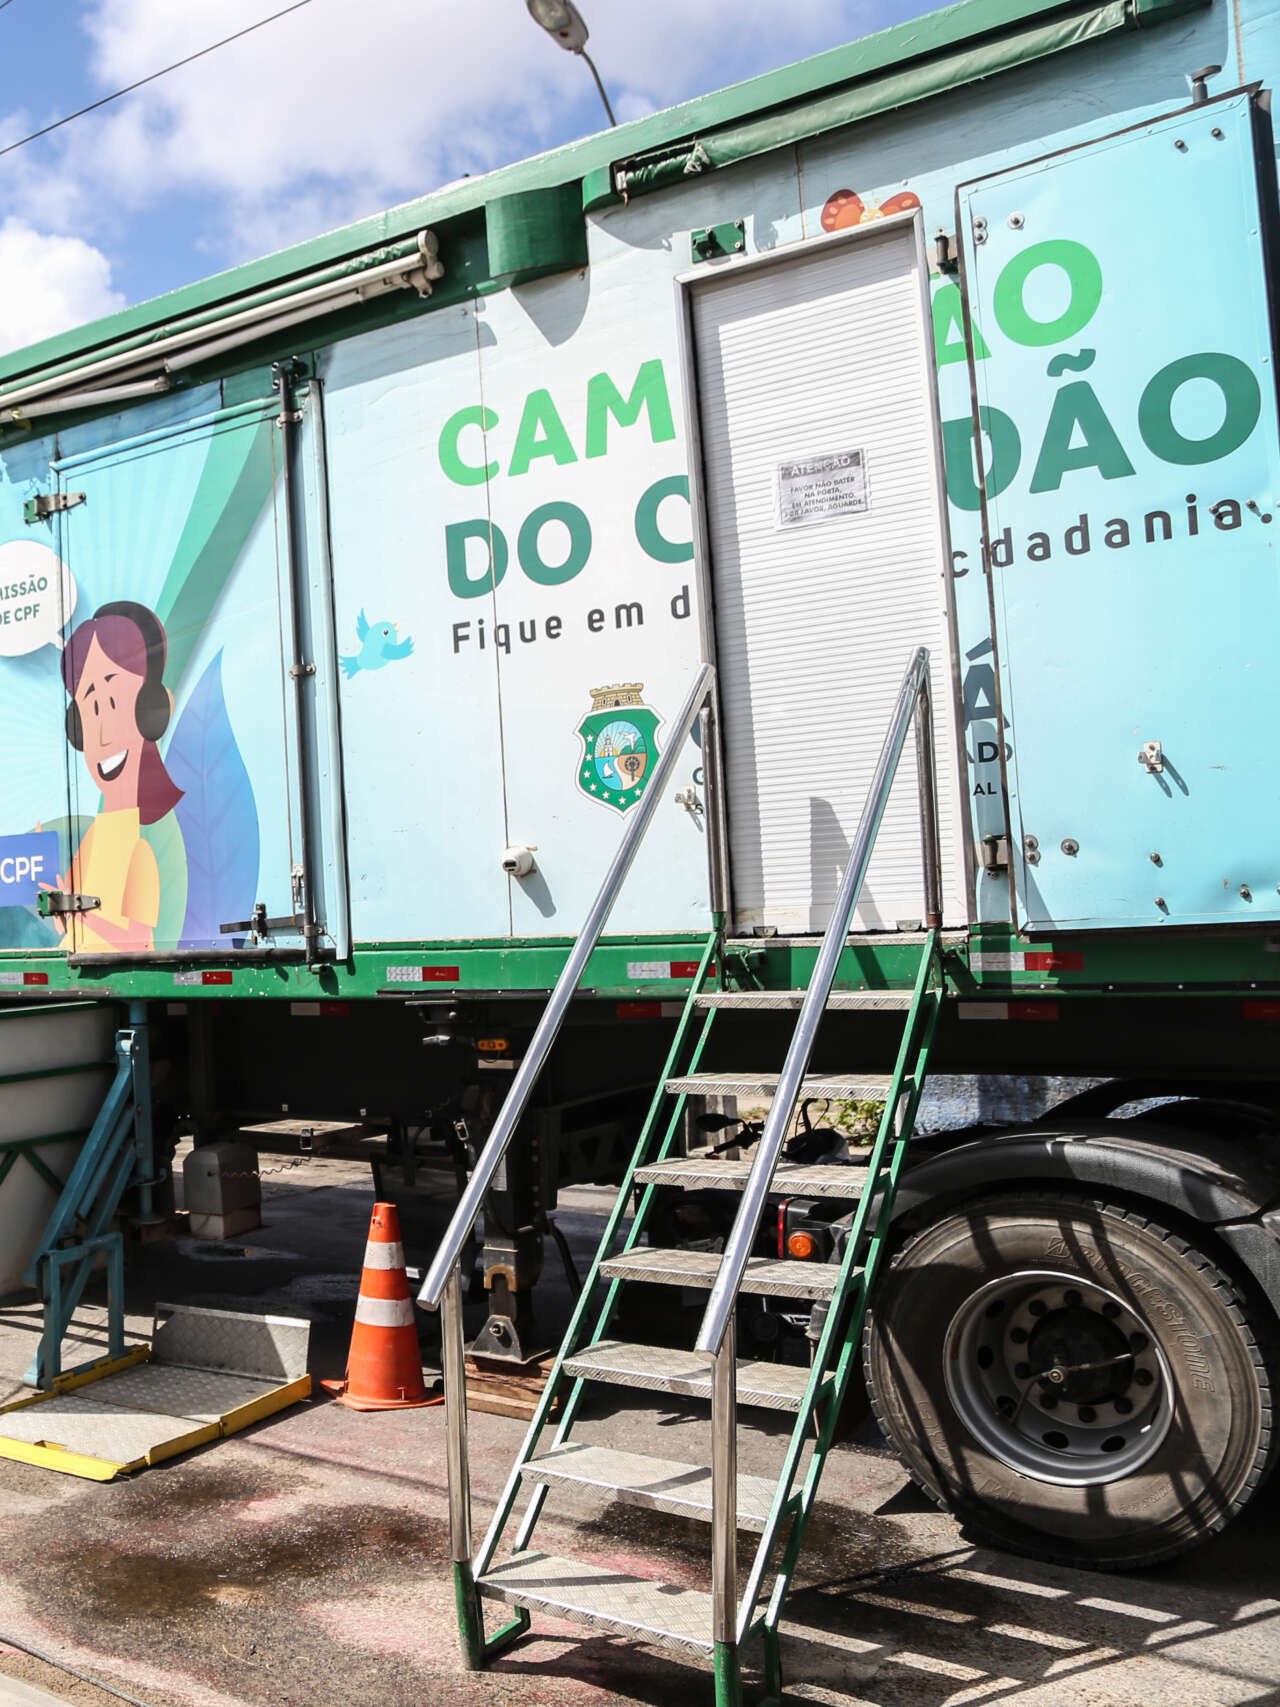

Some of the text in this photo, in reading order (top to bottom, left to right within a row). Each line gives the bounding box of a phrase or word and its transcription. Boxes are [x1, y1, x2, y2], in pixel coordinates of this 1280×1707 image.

[791, 455, 851, 478] ATENÇÃO
[790, 476, 856, 495] FAVOR NÃO BATER
[804, 491, 815, 499] NA
[792, 501, 802, 510] EM
[445, 500, 593, 600] DO
[14, 603, 41, 622] CPF
[452, 615, 563, 654] Fique
[587, 601, 644, 633] em
[0, 855, 43, 884] CPF
